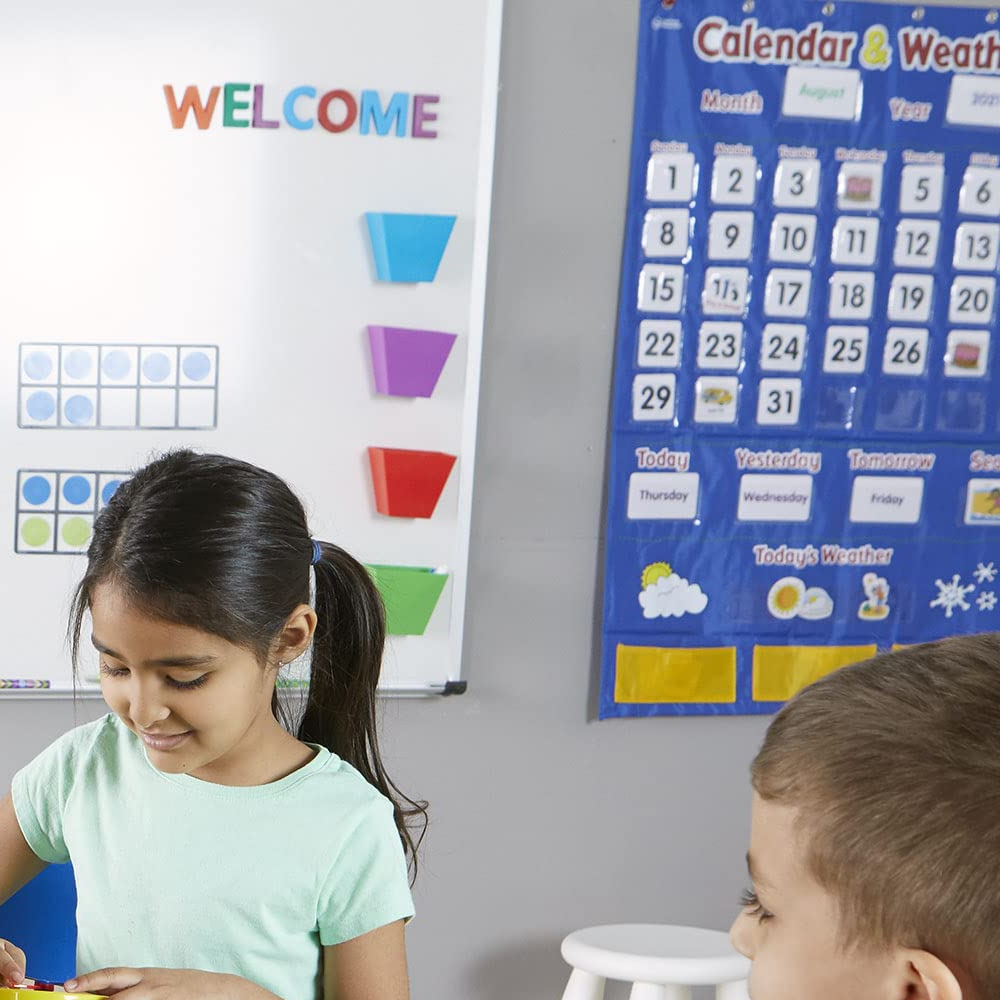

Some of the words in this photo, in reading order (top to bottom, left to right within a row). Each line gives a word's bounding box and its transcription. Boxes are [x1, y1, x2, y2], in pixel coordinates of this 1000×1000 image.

[698, 22, 852, 62] Calendar
[863, 30, 888, 65] &
[903, 32, 1000, 69] Weath
[163, 83, 440, 138] WELCOME
[702, 91, 763, 113] Month
[891, 98, 931, 120] Year
[668, 165, 677, 190] 1
[728, 168, 743, 193] 2
[790, 171, 804, 196] 3
[915, 177, 929, 202] 5
[976, 180, 991, 204] 6
[660, 221, 675, 246] 8
[724, 224, 740, 248] 9
[782, 226, 808, 252] 10
[847, 229, 867, 253] 11
[907, 231, 930, 256] 12
[967, 235, 991, 260] 13
[650, 276, 675, 302] 15
[778, 281, 803, 305] 17
[841, 284, 865, 309] 18
[901, 286, 925, 310] 19
[957, 288, 989, 313] 20
[644, 332, 676, 357] 22
[705, 333, 736, 359] 23
[768, 335, 799, 361] 24
[831, 338, 863, 363] 25
[891, 339, 921, 365] 26
[640, 385, 672, 410] 29
[767, 389, 793, 415] 31
[636, 449, 690, 471] Today
[736, 449, 821, 472] Yesterday
[850, 451, 935, 470] Tomorrow
[639, 489, 689, 504] Thursday
[743, 490, 809, 506] Wednesday
[870, 493, 904, 507] Friday
[754, 546, 818, 568] Today's
[822, 547, 893, 566] Weather
